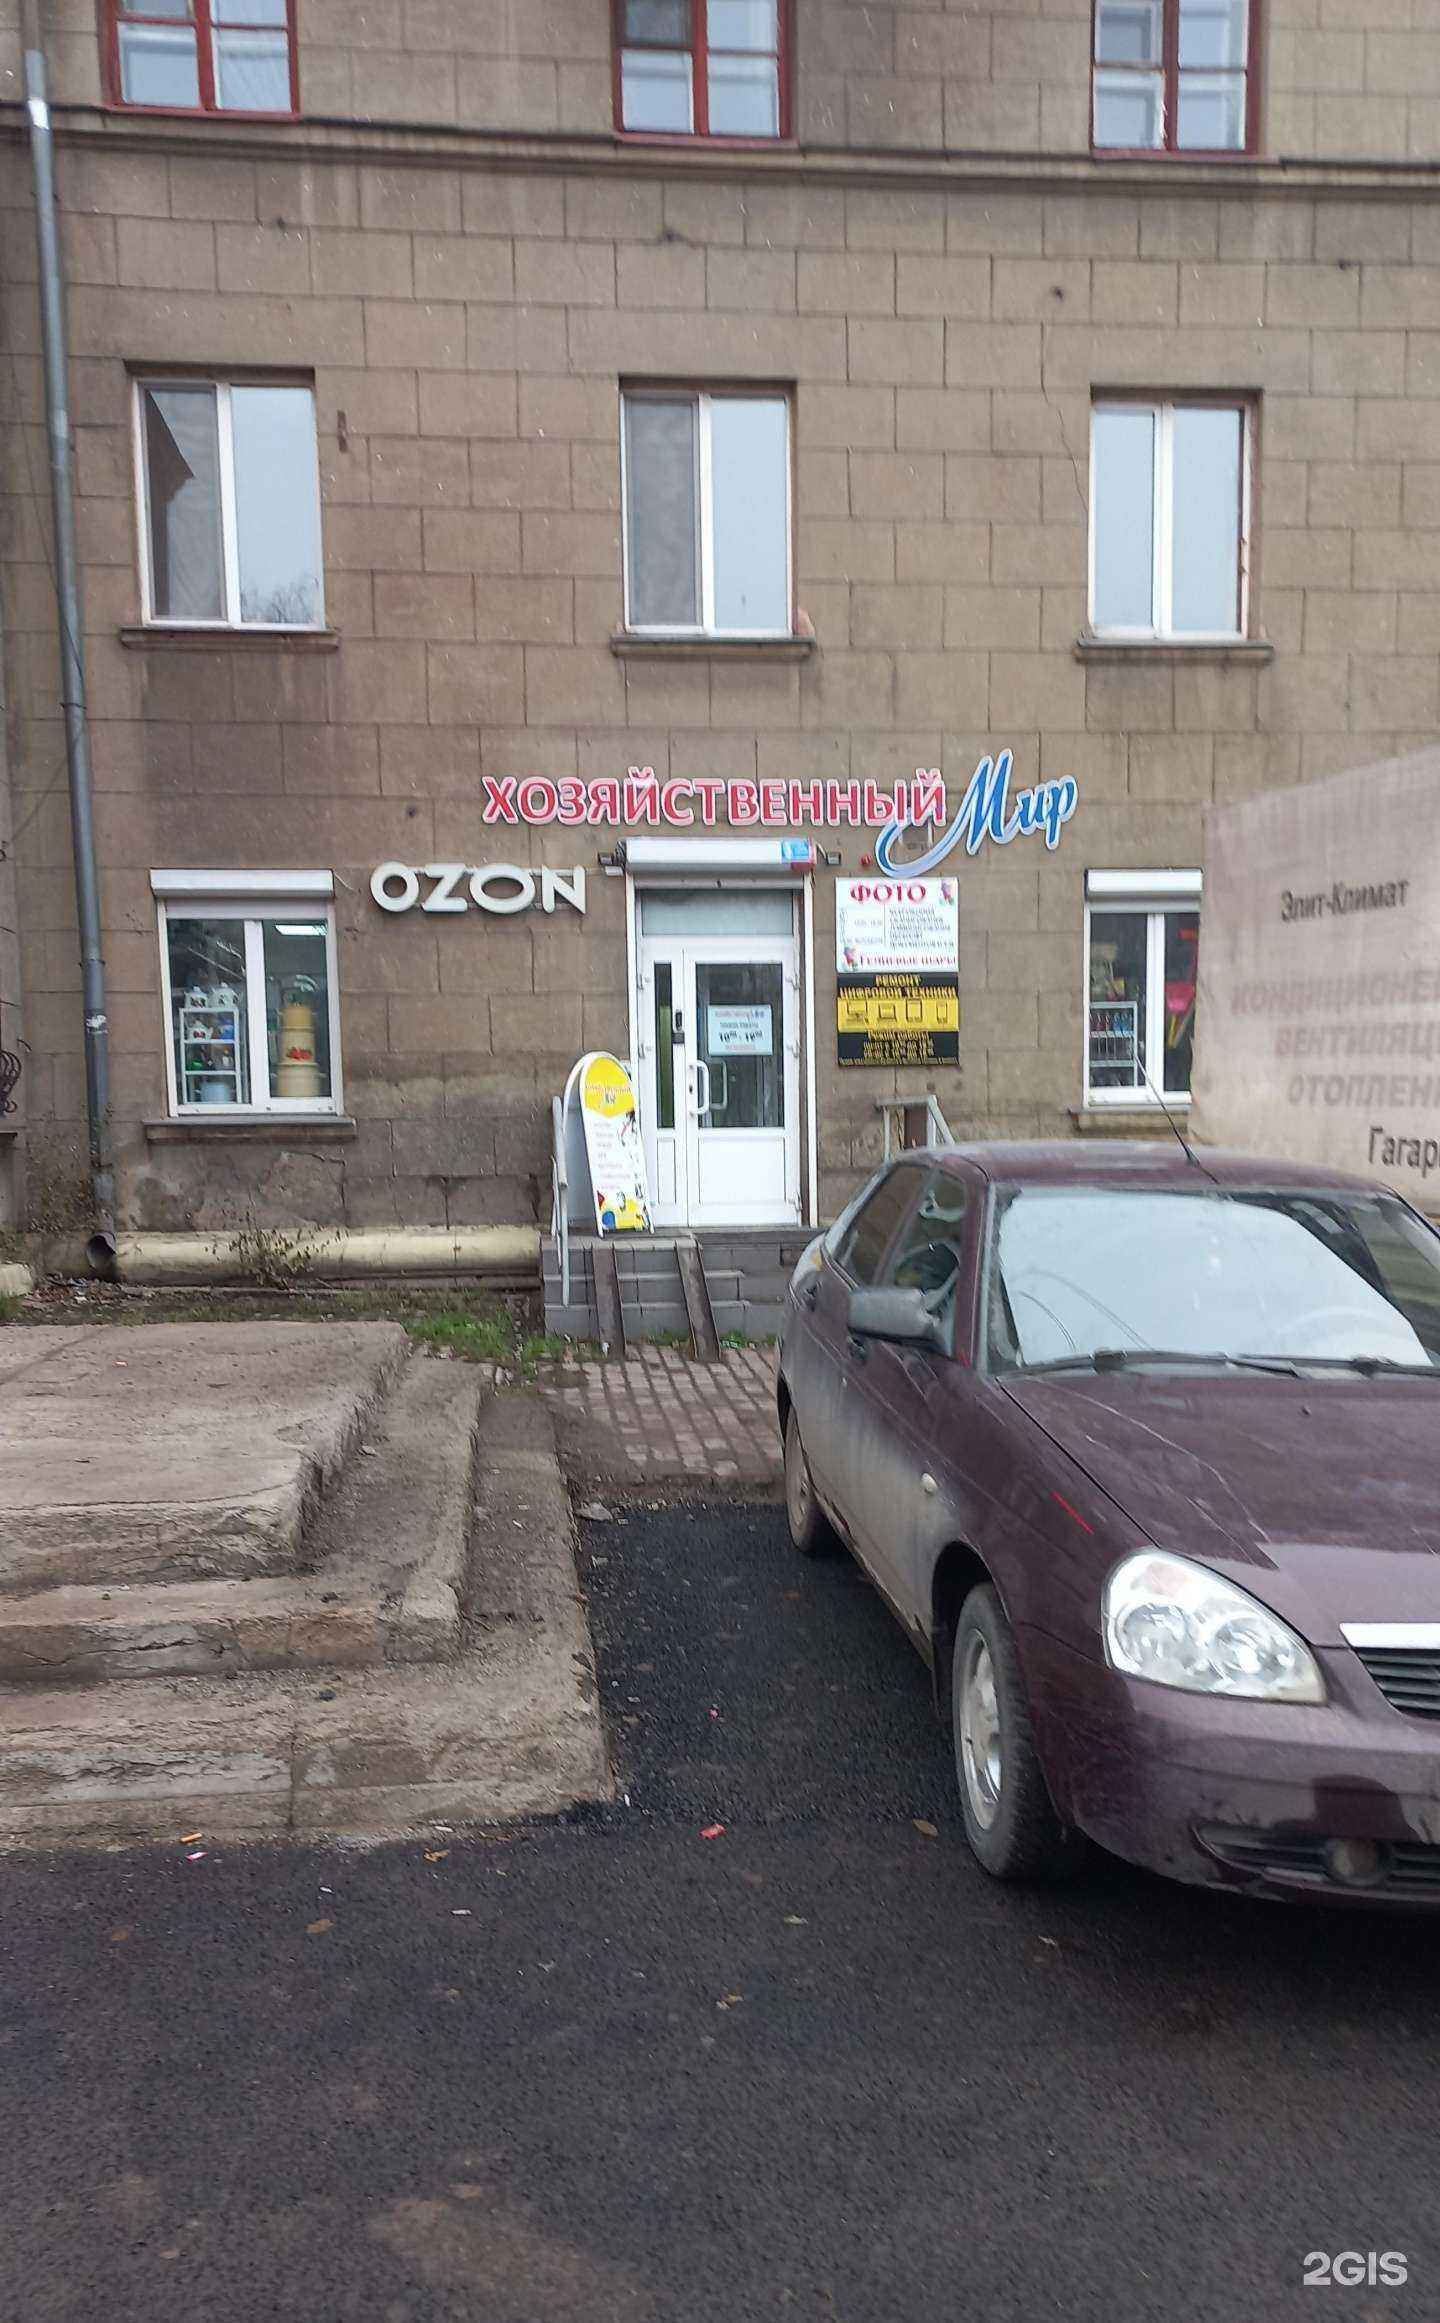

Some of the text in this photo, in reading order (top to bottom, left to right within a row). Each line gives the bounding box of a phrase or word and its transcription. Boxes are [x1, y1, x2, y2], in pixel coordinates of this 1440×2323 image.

[481, 748, 1078, 879] ХОЗЯЙСТВЕННЫЙ Мир
[370, 861, 586, 915] OZON
[849, 882, 926, 903] ФОТО
[1280, 879, 1409, 923] Элит-Климат
[875, 974, 921, 987] РЕМОНТ
[1231, 967, 1440, 1017] КОНДИЦИОНЕ
[1274, 1021, 1440, 1062] ВЕНТИЛЯЦ
[1286, 1074, 1440, 1108] ОТОПЛЕН
[1368, 1126, 1440, 1178] Гагар
